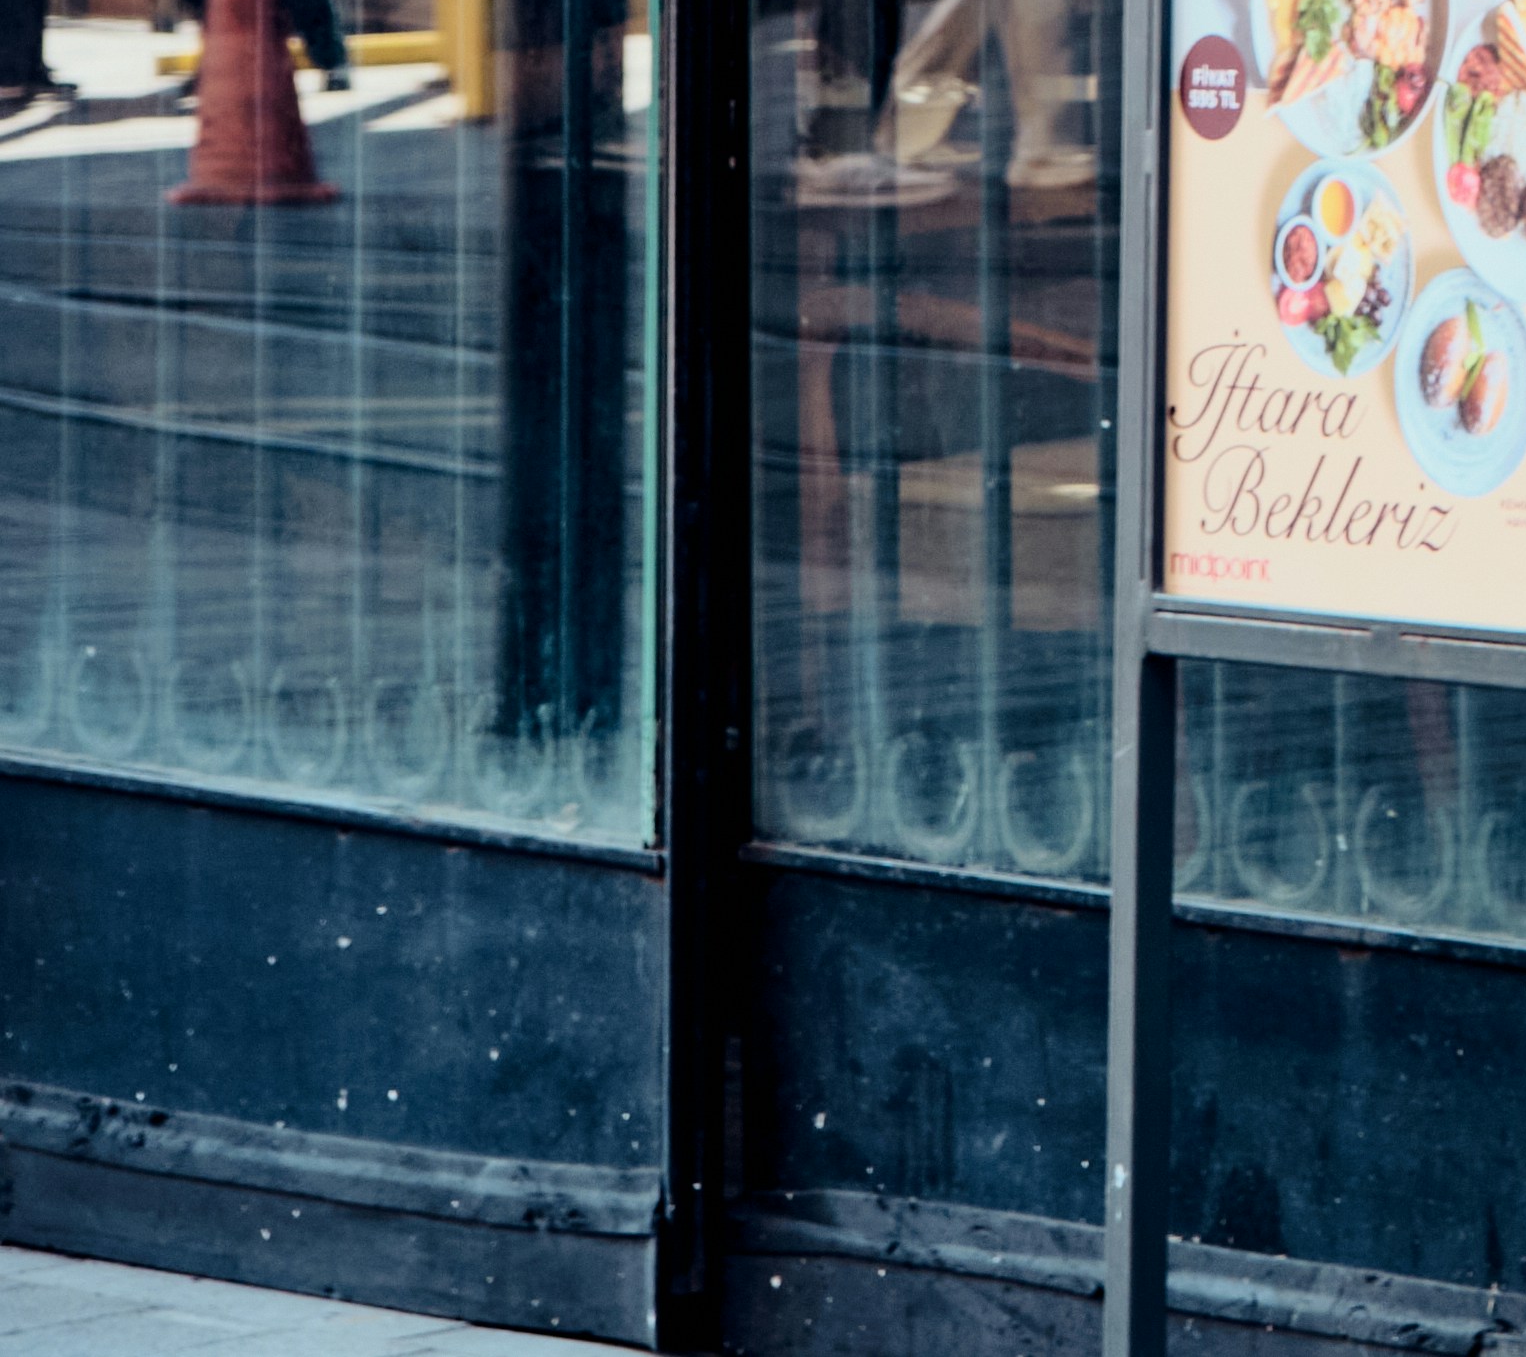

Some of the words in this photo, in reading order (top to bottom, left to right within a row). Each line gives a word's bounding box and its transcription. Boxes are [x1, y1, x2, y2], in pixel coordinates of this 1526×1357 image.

[1219, 89, 1241, 110] TL
[1168, 329, 1367, 462] İftara
[1199, 442, 1459, 554] Bekleriz
[1169, 549, 1272, 585] midpoint
